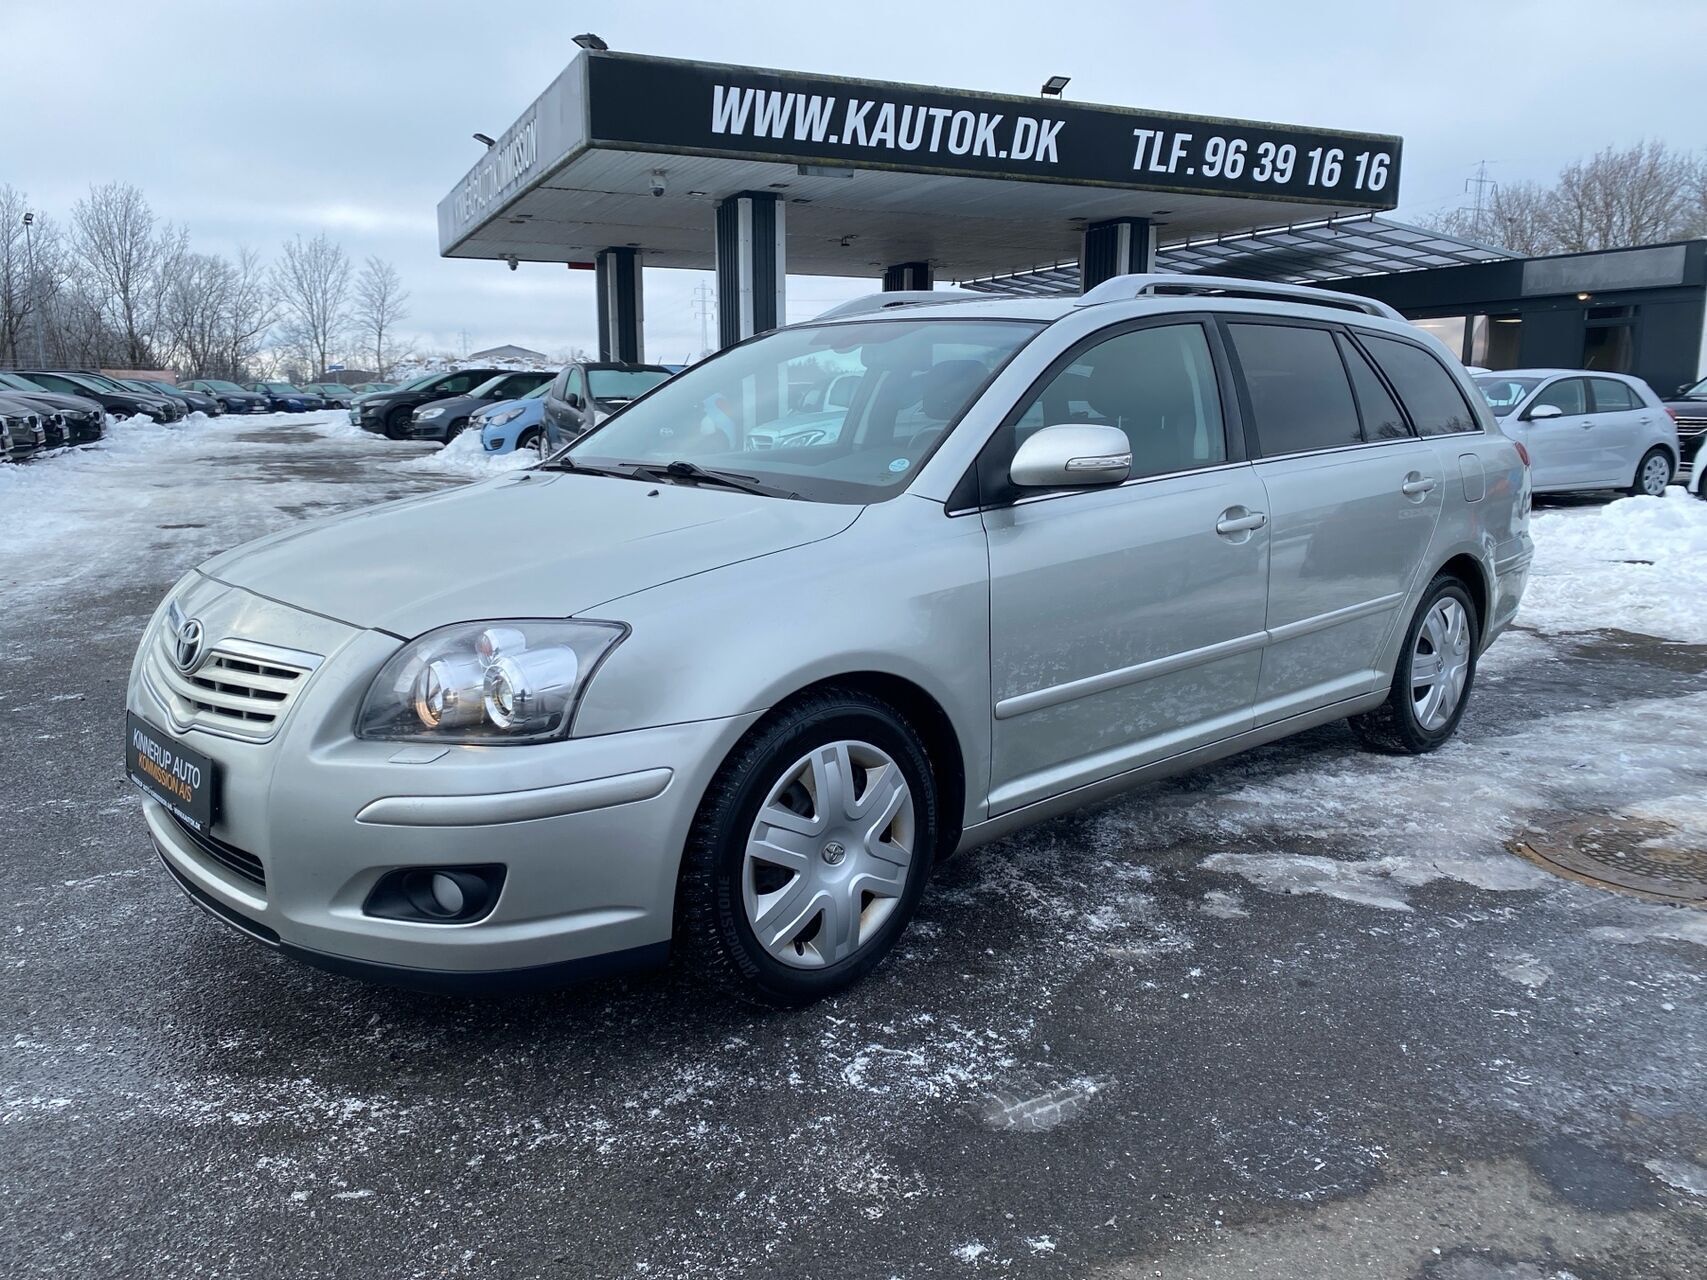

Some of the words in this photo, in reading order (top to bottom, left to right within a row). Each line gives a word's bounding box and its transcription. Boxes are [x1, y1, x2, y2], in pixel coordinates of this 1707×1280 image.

[711, 84, 1066, 163] WWW.KAUTOK.DK
[1132, 128, 1195, 175] TLF.
[1202, 136, 1248, 180] 96
[1253, 141, 1297, 184] 39
[1307, 147, 1344, 188] 16
[1354, 151, 1391, 192] 16
[133, 728, 171, 769] KINNERUP
[172, 756, 200, 789] AUTO
[138, 752, 178, 795] KOMMISSION
[178, 781, 192, 802] A/S
